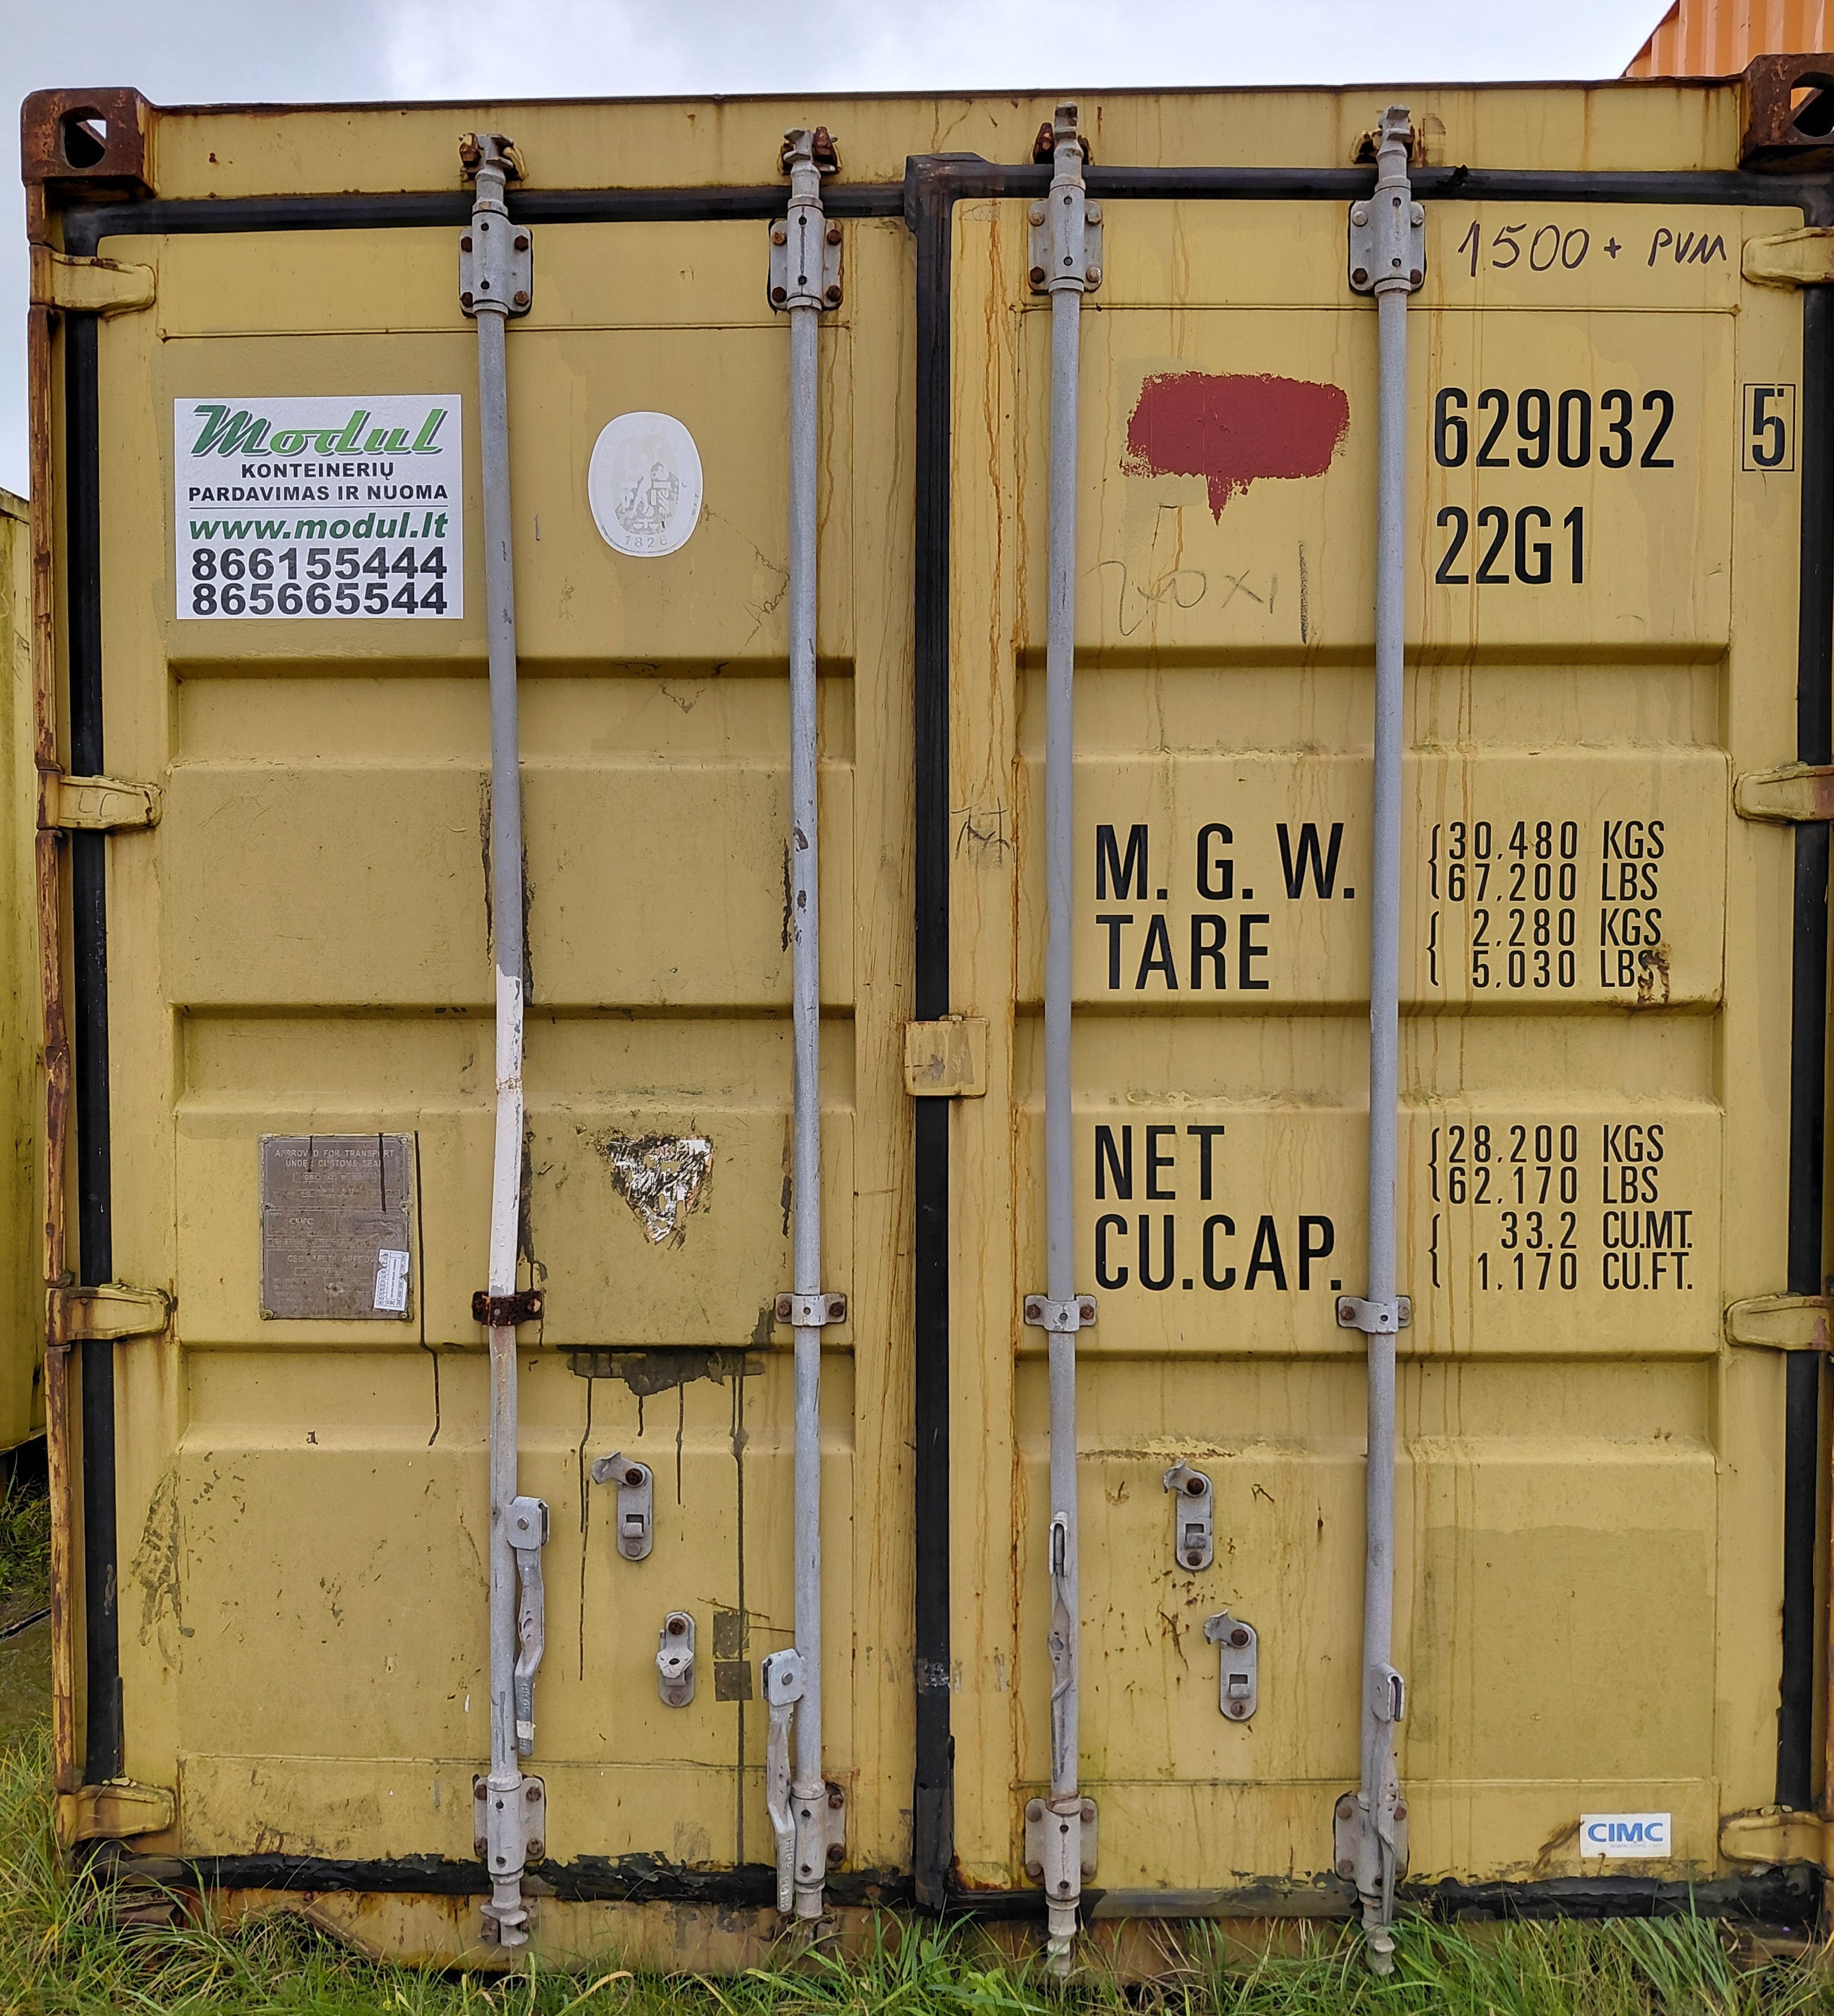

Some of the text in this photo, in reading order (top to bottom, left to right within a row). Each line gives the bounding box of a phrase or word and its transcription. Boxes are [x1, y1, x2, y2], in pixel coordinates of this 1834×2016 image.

[1458, 220, 1589, 277] 1500
[191, 405, 448, 458] Modul
[1434, 387, 1786, 468] 629032 5
[241, 462, 394, 481] KONTEINERIŲ
[188, 484, 448, 502] PARDAVIMAS IR NUOMA
[189, 512, 449, 540] www.modul.lt
[1435, 506, 1583, 584] 22G1
[191, 546, 448, 581] 866155444
[192, 582, 448, 616] 865665544
[1603, 820, 1665, 860] KGS
[1601, 862, 1659, 901] LBS
[1600, 908, 1663, 947] KGS
[1095, 914, 1270, 990] TARE
[1094, 1125, 1225, 1201] NET
[1603, 1124, 1664, 1163] KGS
[1603, 1165, 1658, 1204] LBS
[1501, 1210, 1693, 1249] 33.2 CU.MT.
[1094, 1213, 1342, 1291] CU.CAP.
[1603, 1252, 1693, 1291] CU.FT.
[1588, 1823, 1664, 1842] CIMC
